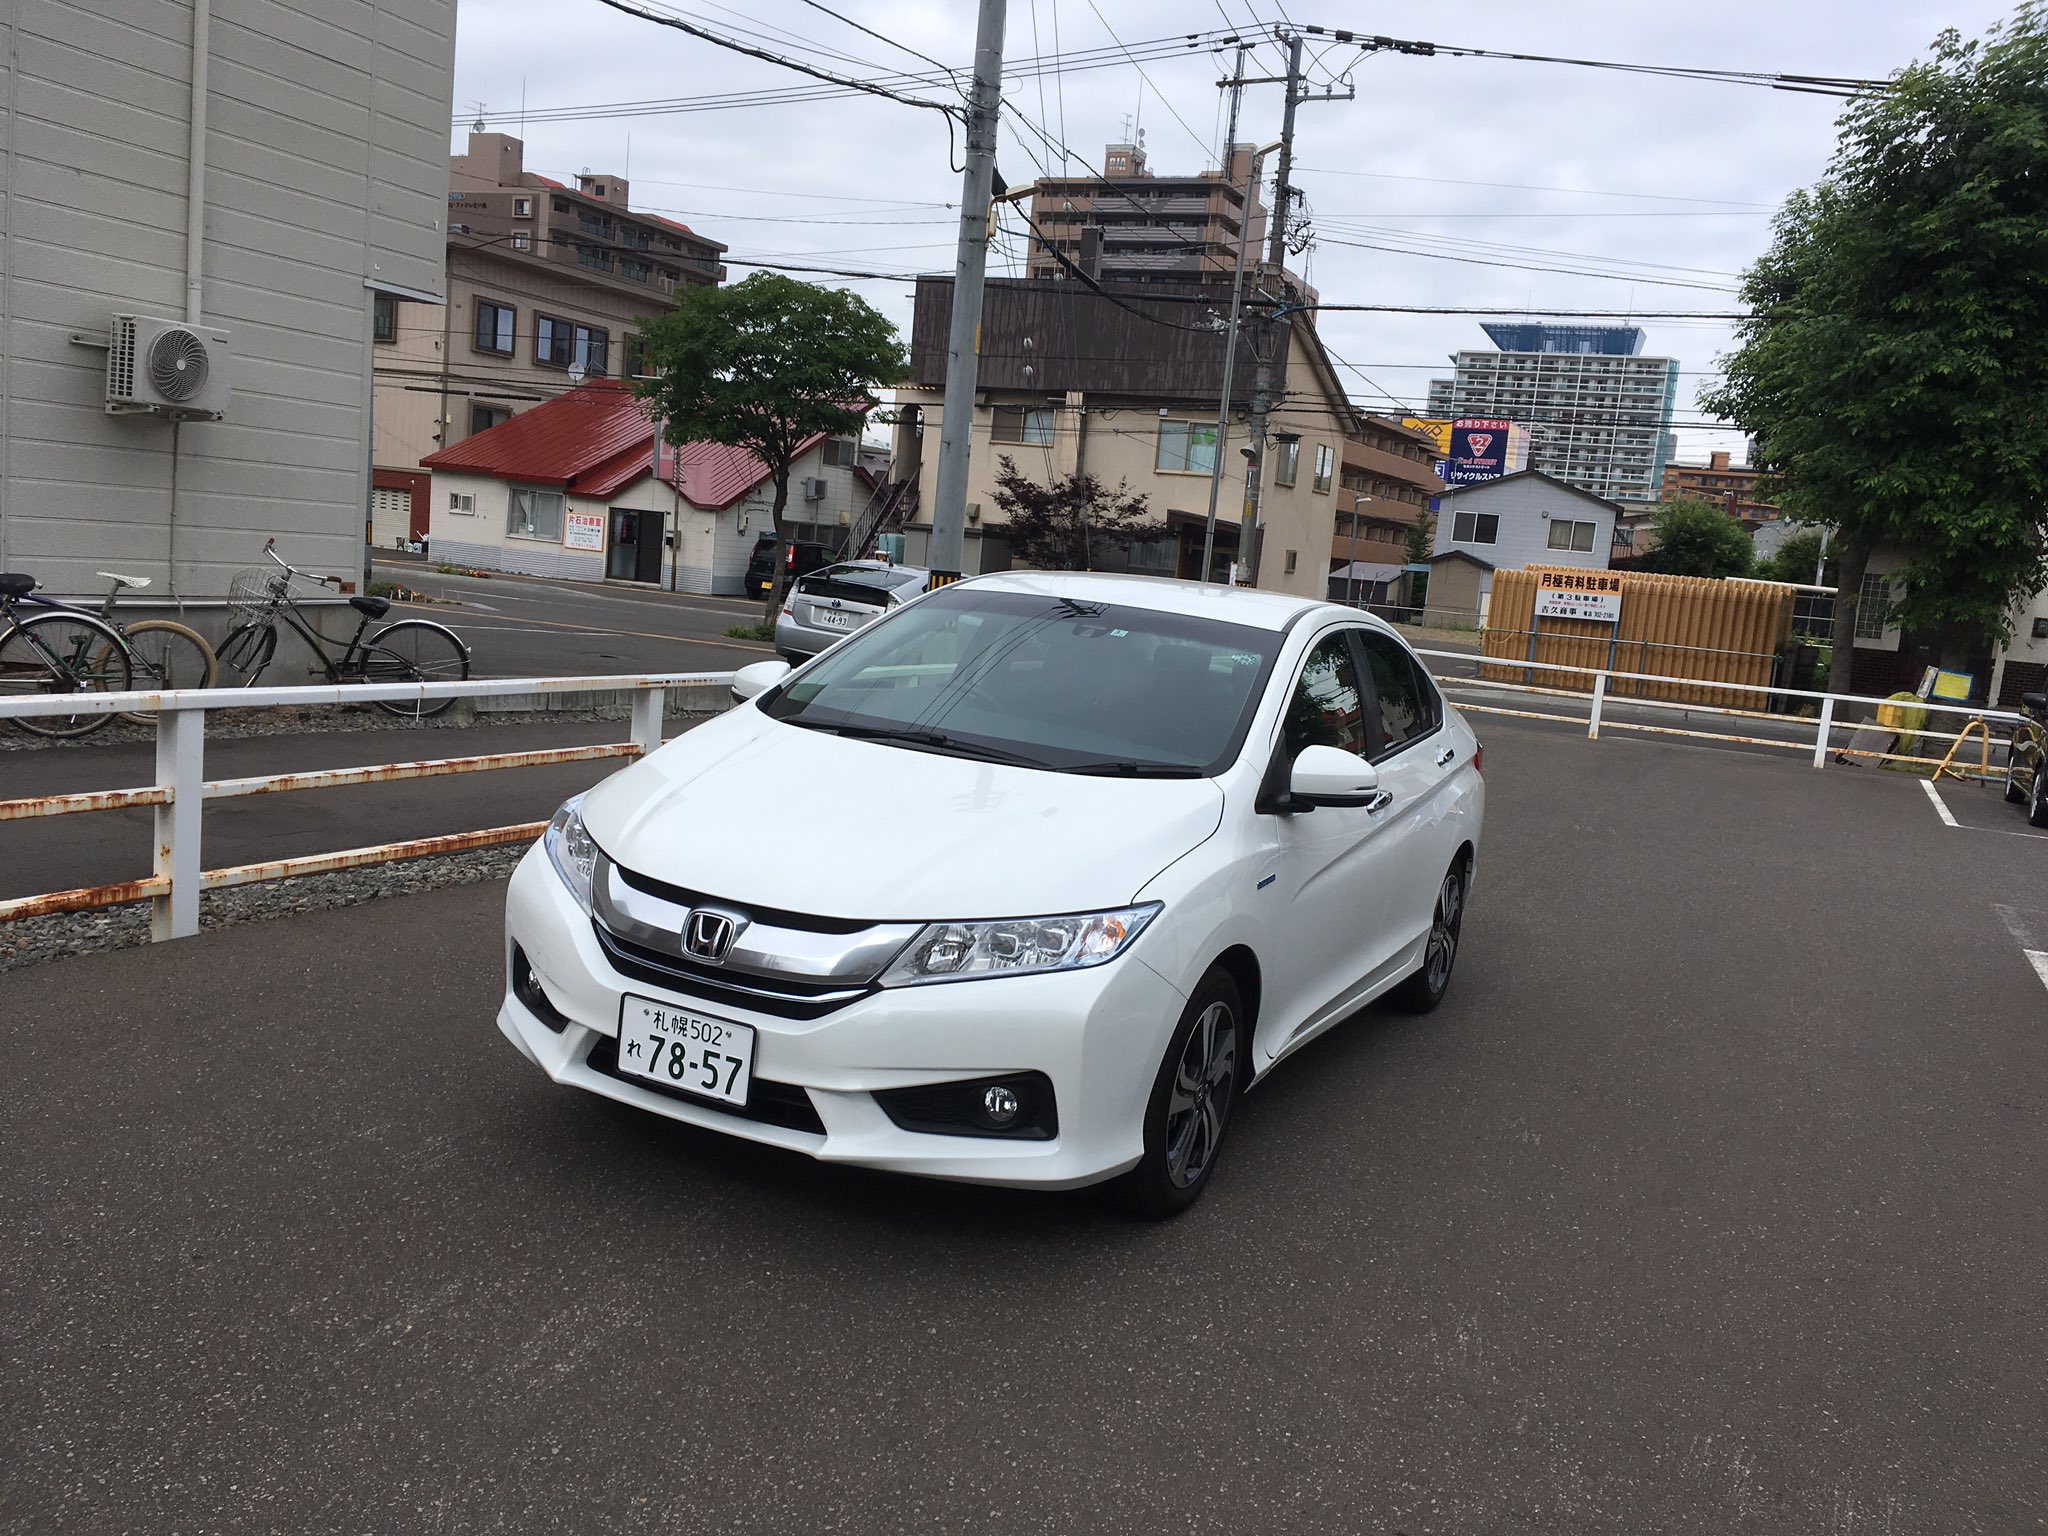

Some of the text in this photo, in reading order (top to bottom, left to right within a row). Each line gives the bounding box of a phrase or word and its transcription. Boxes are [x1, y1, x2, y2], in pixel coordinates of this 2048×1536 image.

[1456, 419, 1507, 429] お売り下さい
[1541, 573, 1620, 592] 月極有料駐車場
[827, 615, 847, 626] 44-93
[627, 1033, 743, 1096] れ 78-57
